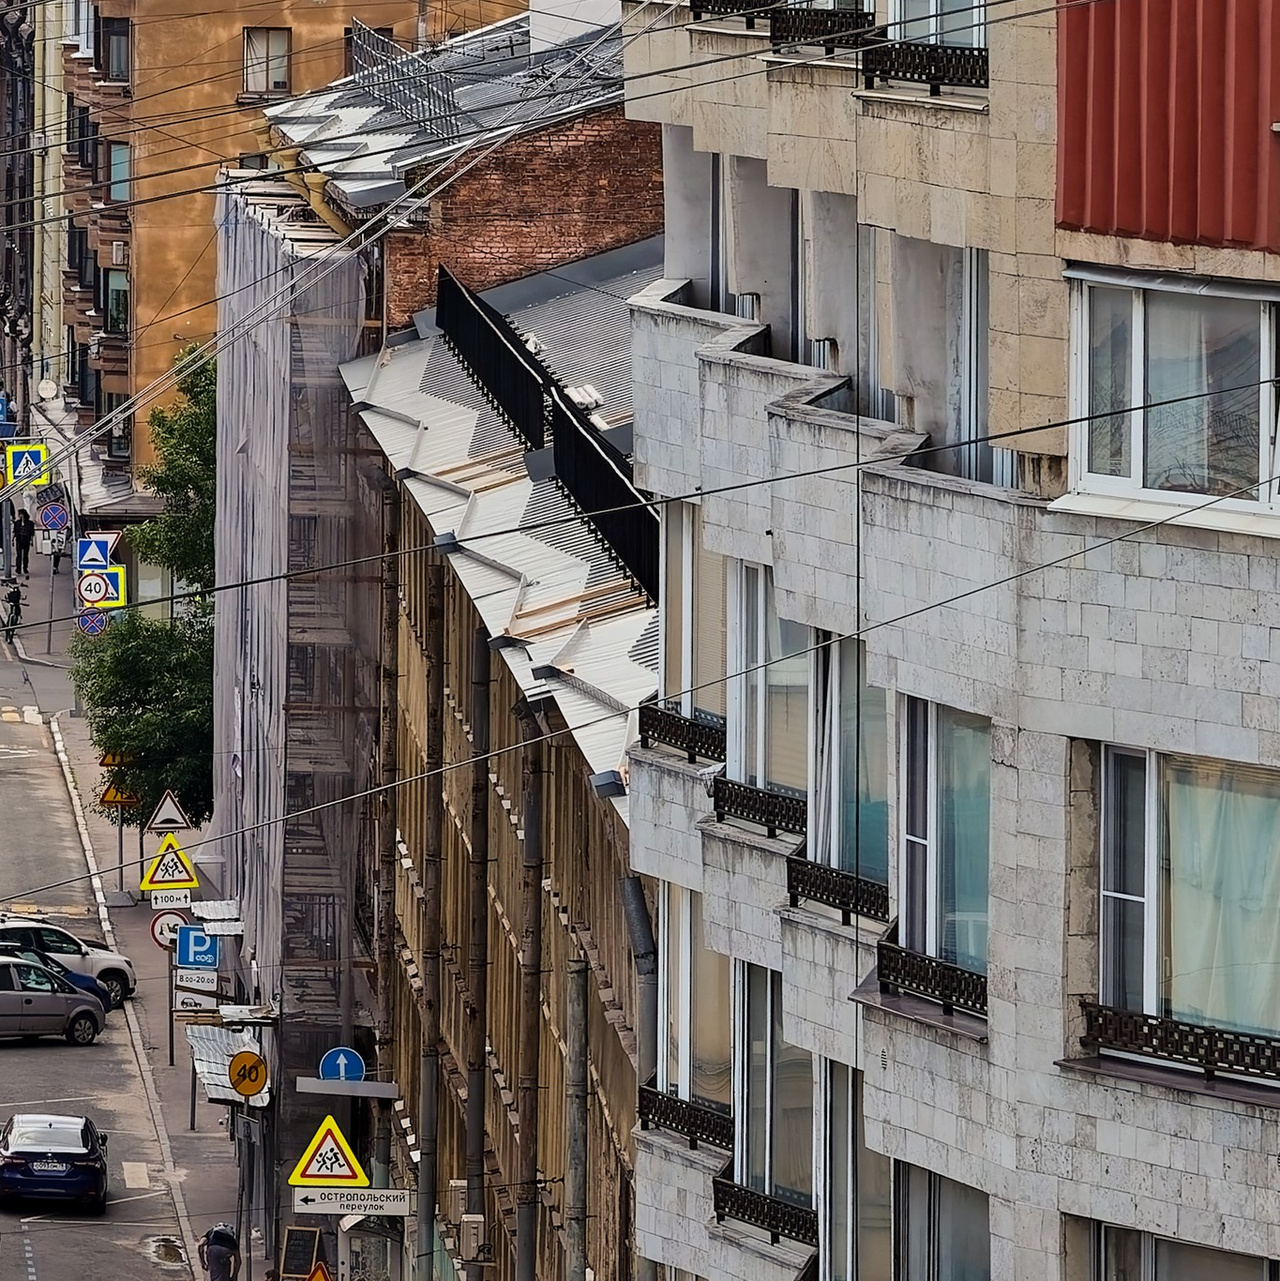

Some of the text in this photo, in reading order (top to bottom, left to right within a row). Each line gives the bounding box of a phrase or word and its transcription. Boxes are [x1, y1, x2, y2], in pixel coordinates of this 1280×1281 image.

[84, 582, 101, 594] 40
[160, 894, 182, 903] 100м
[189, 931, 211, 962] P
[236, 1064, 259, 1083] 40
[320, 1191, 406, 1203] ОСТРОПОЛЬСКИЙ
[339, 1201, 385, 1212] переулок
